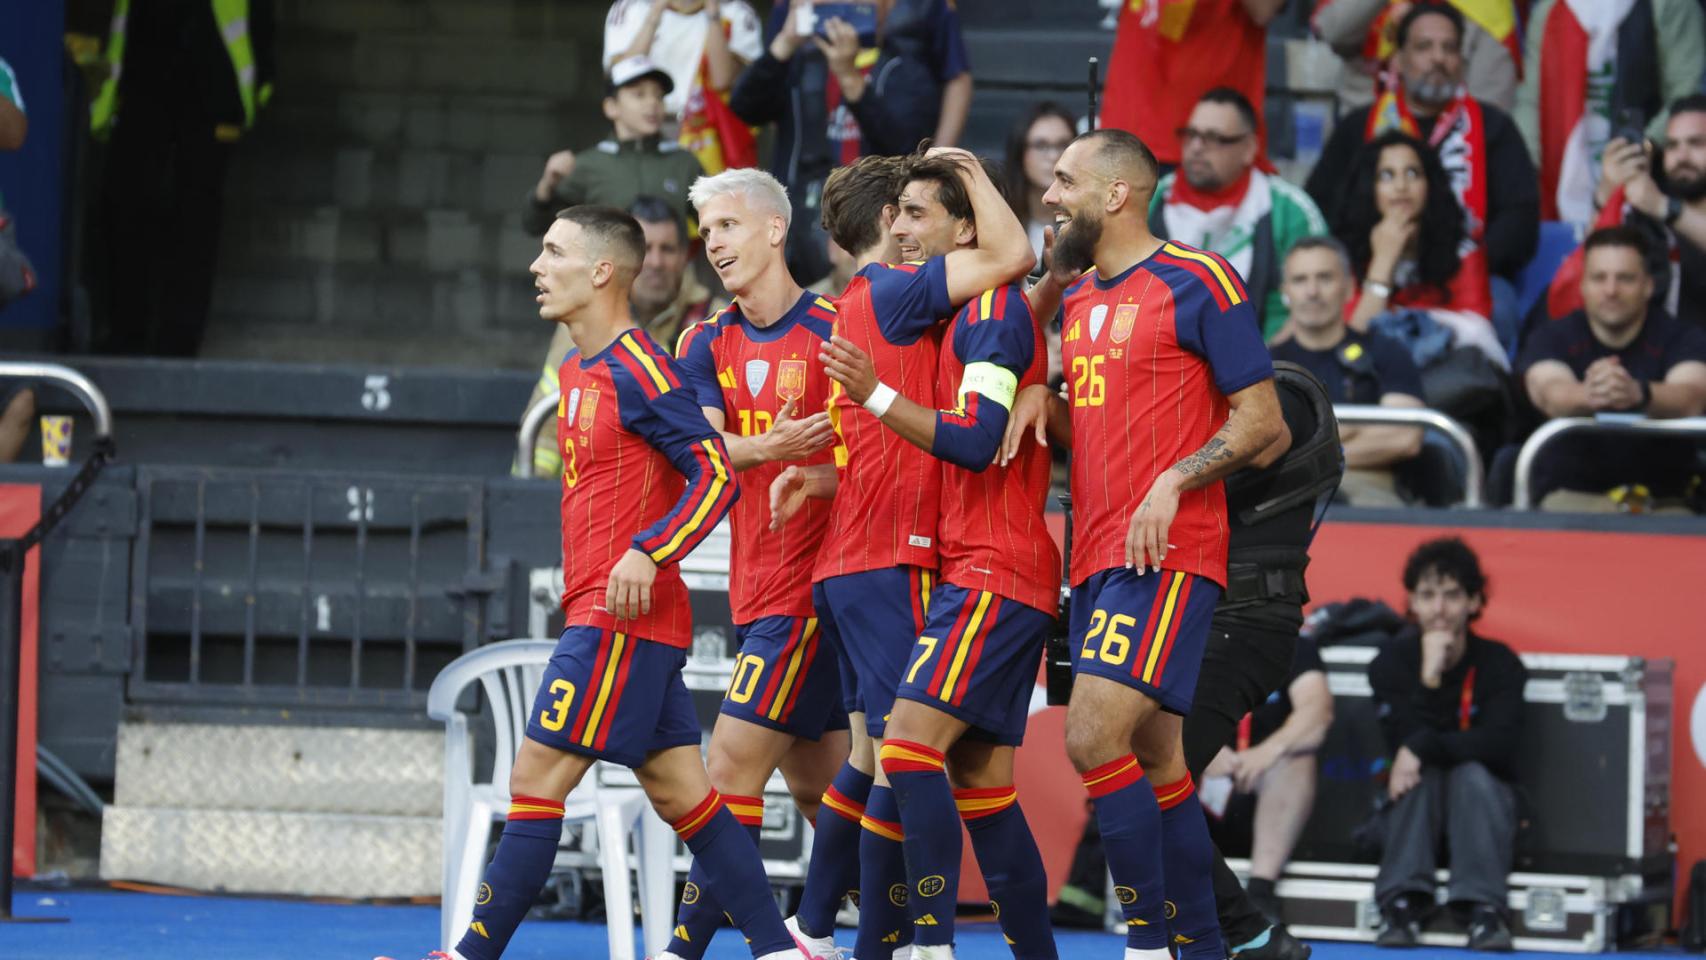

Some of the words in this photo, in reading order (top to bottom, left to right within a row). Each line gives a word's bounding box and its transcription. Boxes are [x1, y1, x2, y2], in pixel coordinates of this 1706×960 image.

[1072, 354, 1106, 407] 26
[565, 438, 577, 488] 3
[907, 637, 938, 683] 7
[1080, 609, 1136, 665] 26
[540, 679, 575, 732] 3
